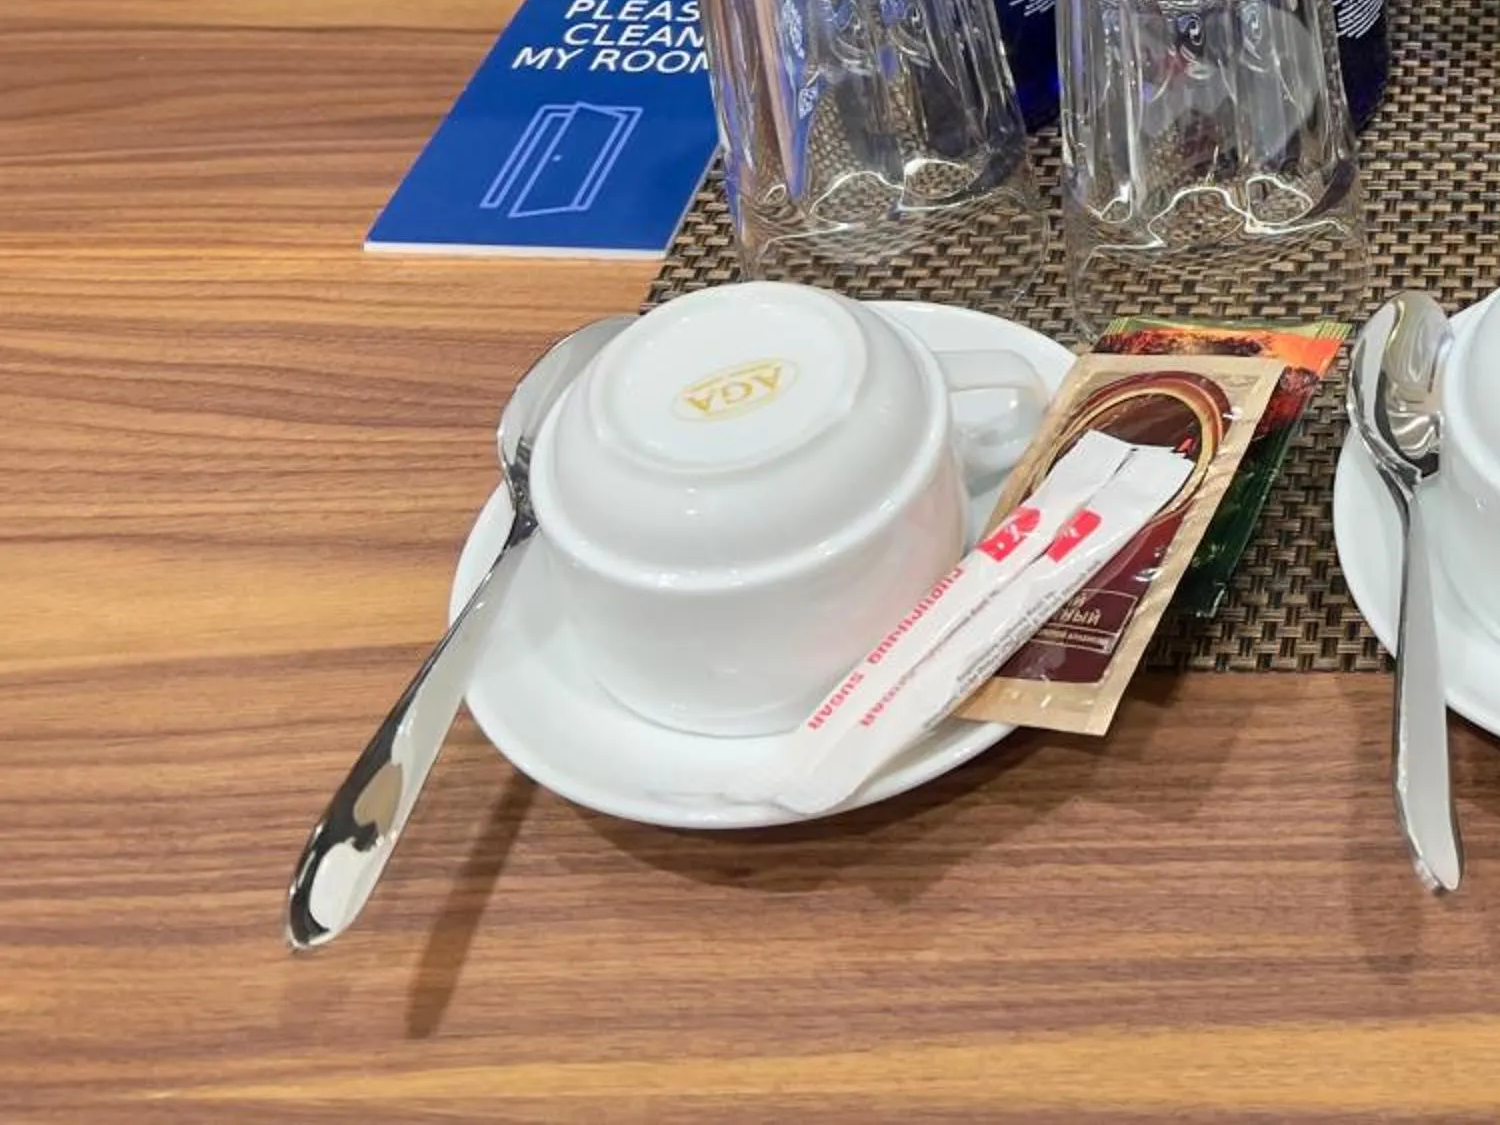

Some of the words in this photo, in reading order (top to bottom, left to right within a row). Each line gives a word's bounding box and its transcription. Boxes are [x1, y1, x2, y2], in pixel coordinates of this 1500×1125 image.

[563, 23, 705, 48] CLEAN
[511, 46, 585, 70] MY
[685, 363, 787, 414] AGA
[808, 671, 864, 730] SUGAR
